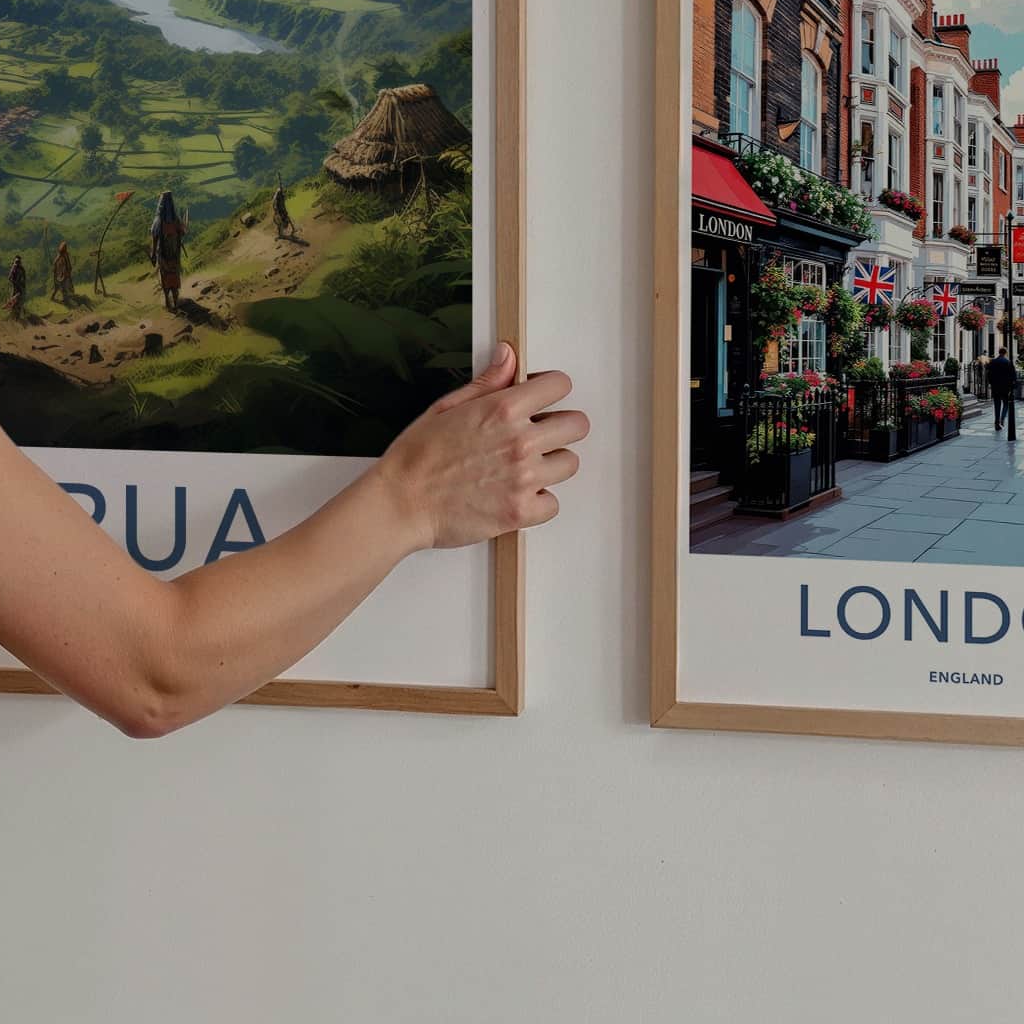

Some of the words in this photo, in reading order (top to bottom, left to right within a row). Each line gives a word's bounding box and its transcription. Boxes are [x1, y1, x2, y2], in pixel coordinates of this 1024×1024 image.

[698, 213, 753, 242] LONDON
[800, 584, 1024, 645] LOND
[929, 671, 1004, 686] ENGLAND
